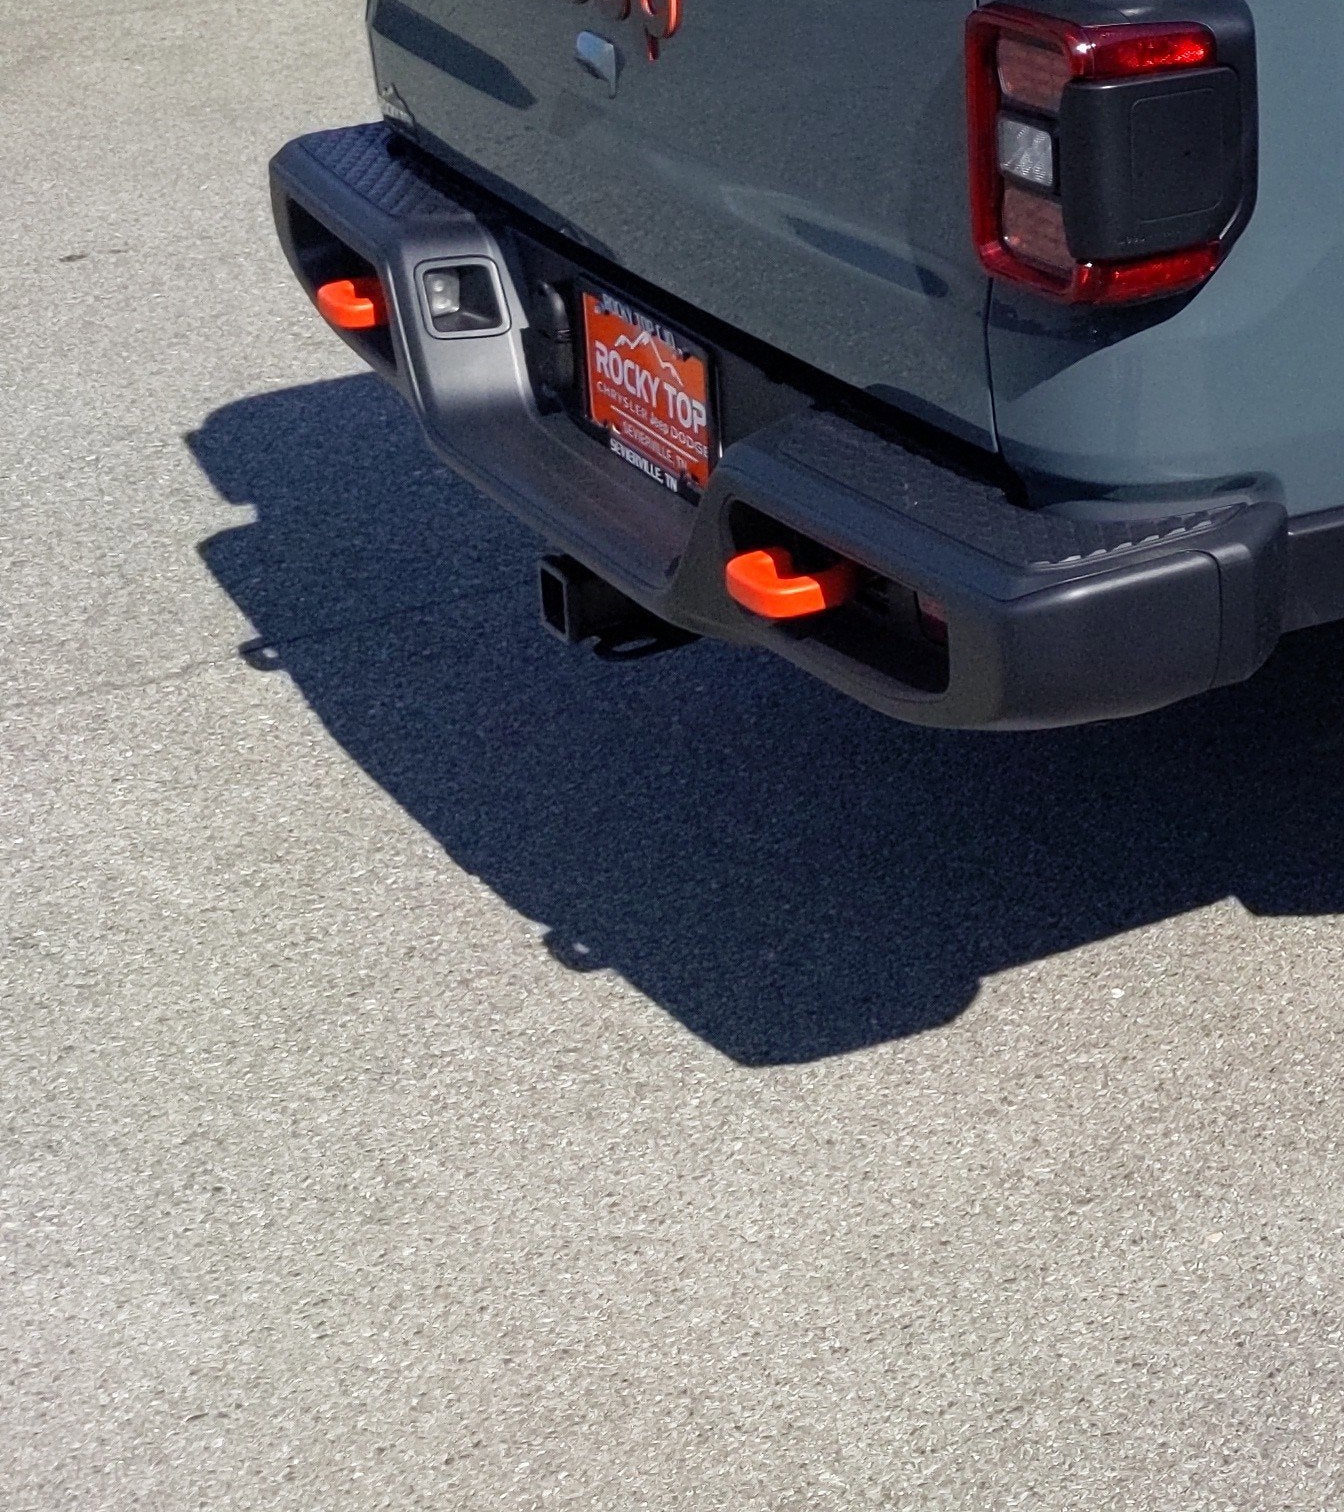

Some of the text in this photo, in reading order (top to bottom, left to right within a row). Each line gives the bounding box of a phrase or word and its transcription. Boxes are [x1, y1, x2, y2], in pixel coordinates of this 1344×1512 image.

[595, 339, 707, 434] ROCKY TOP
[597, 381, 648, 419] CHRYSLER
[670, 425, 708, 458] DODGE
[664, 472, 678, 492] TN
